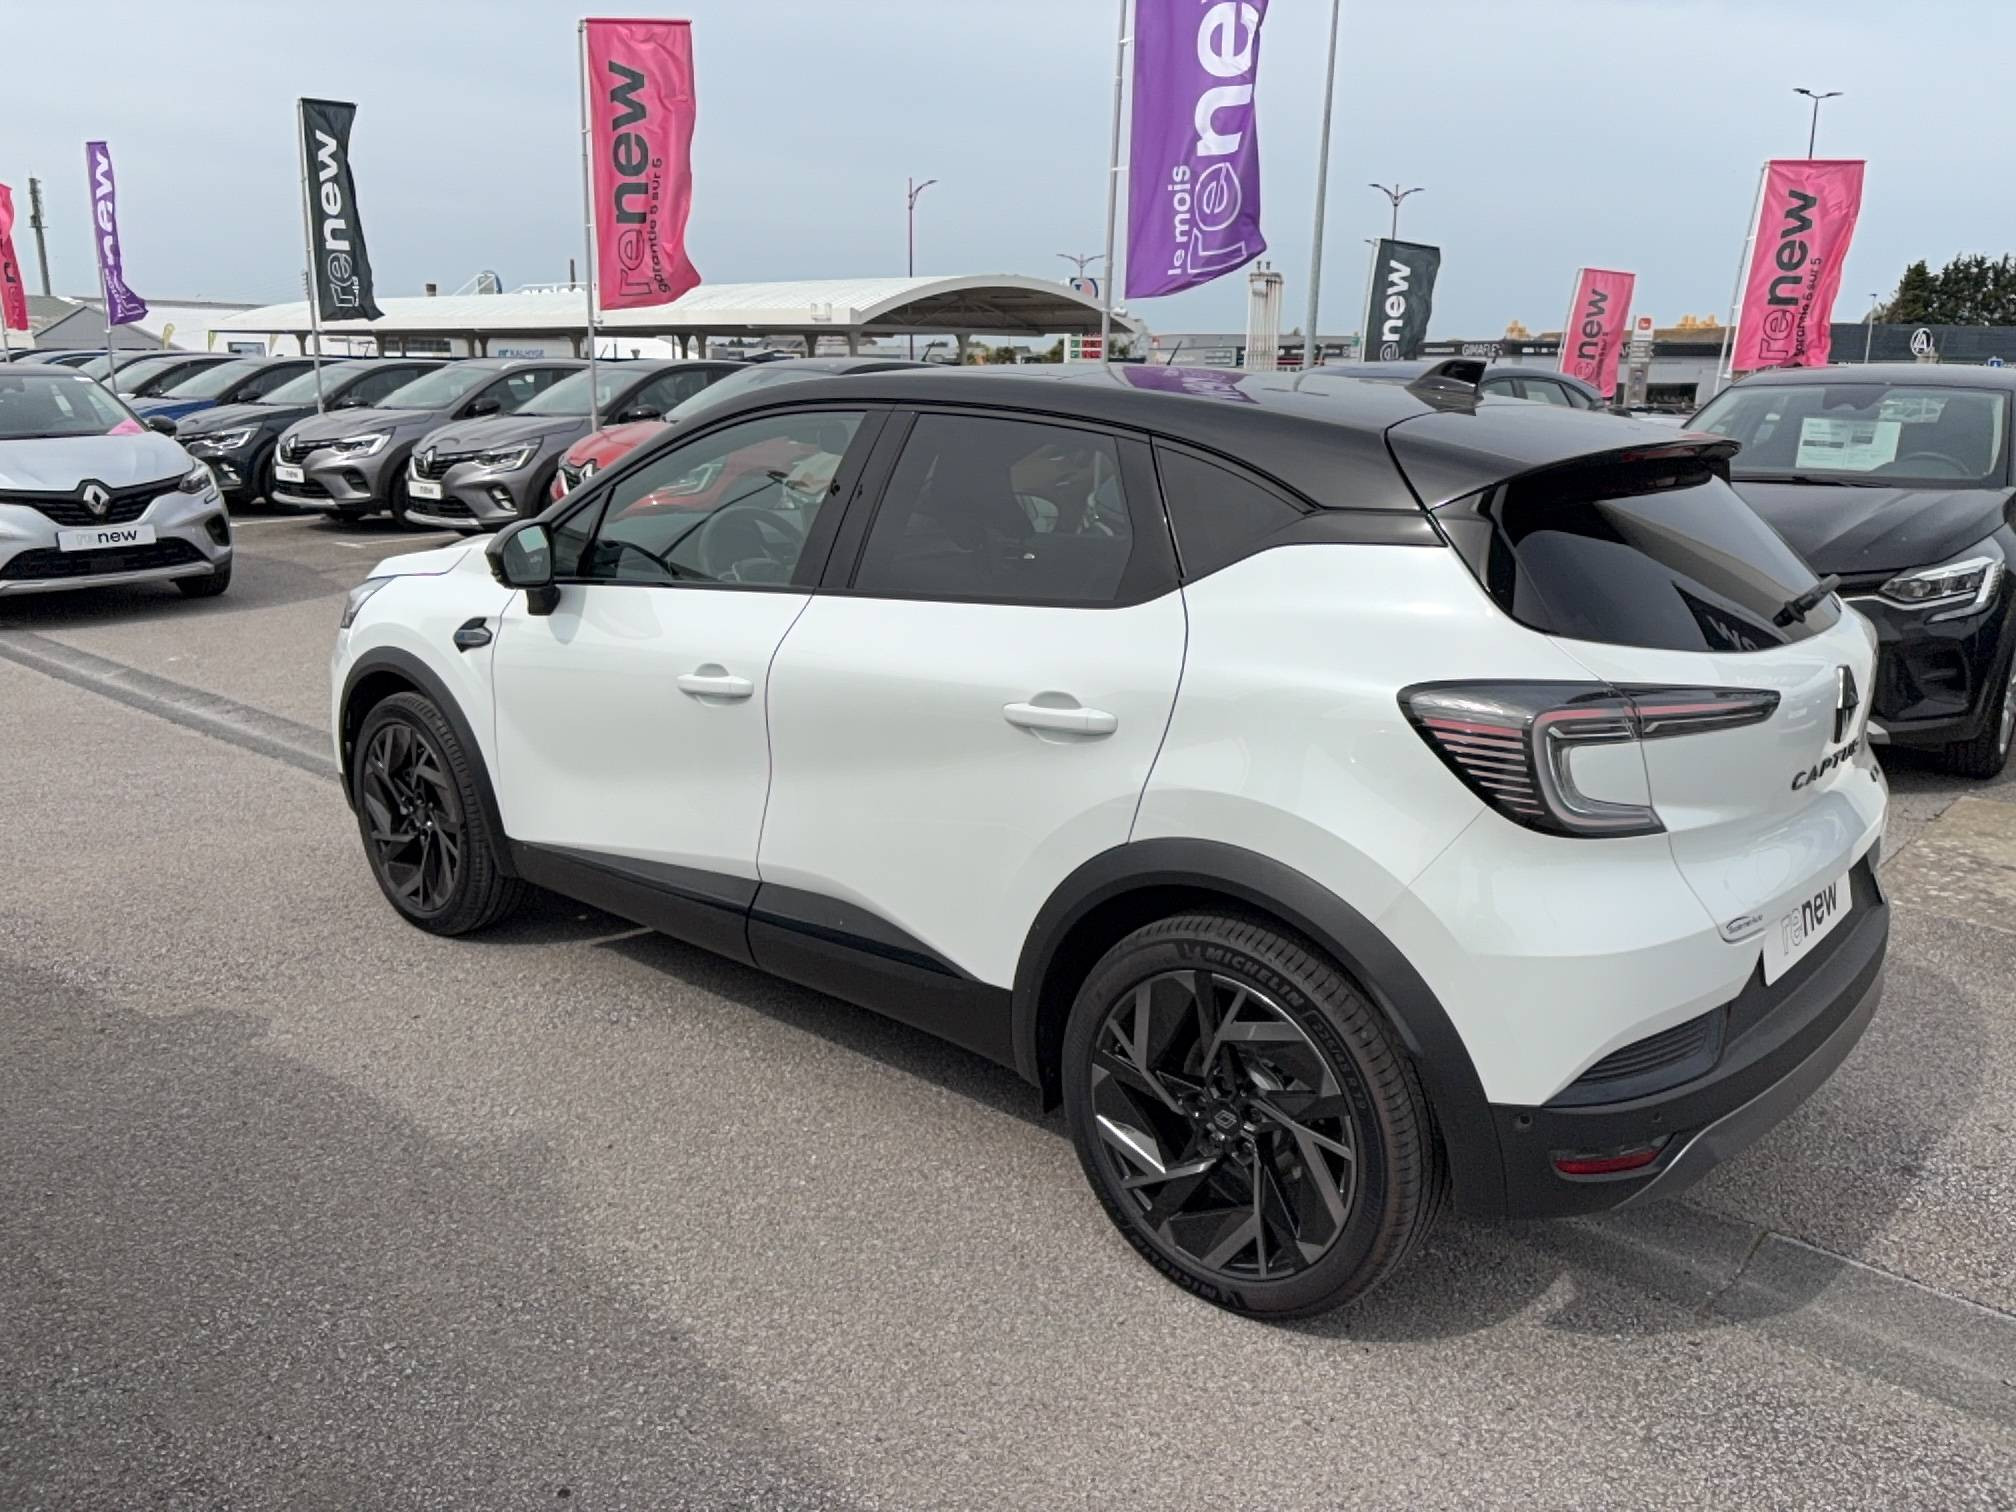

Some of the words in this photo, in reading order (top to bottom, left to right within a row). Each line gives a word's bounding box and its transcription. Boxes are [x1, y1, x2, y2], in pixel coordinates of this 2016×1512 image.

[315, 129, 353, 307] renew
[608, 60, 652, 297] renew
[1167, 164, 1192, 243] mois
[1187, 0, 1260, 274] rene
[1167, 248, 1185, 276] le
[1758, 188, 1818, 361] renew
[1780, 881, 1838, 957] renew
